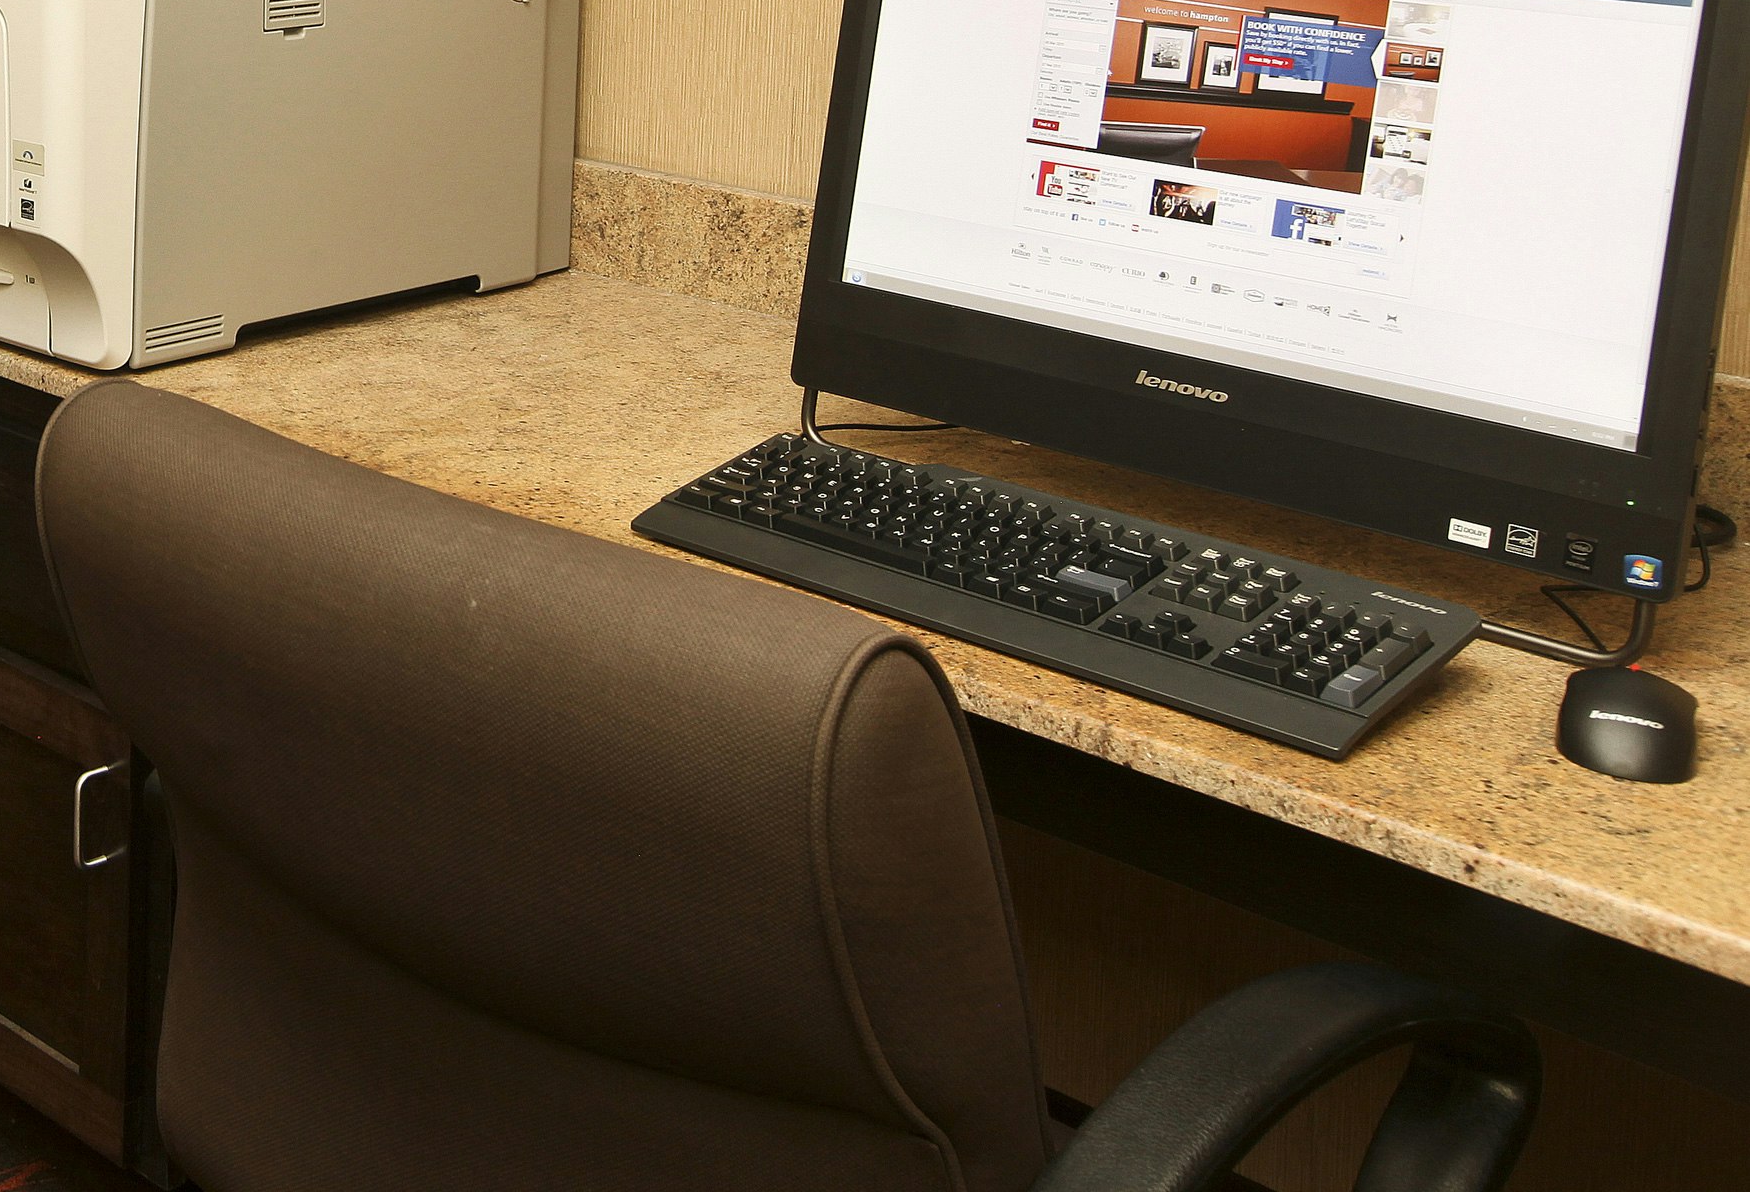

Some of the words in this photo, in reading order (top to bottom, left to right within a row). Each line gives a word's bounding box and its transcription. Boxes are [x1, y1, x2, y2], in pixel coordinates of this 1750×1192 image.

[1144, 5, 1178, 18] welcome
[1180, 9, 1188, 18] to
[1190, 10, 1228, 24] hampton
[1247, 21, 1276, 32] BOOK
[1277, 24, 1302, 36] WITH
[1304, 27, 1366, 42] CONFIDENCE
[1051, 175, 1061, 185] You
[1135, 369, 1229, 404] lenovo
[1370, 591, 1448, 615] lenovo
[1589, 710, 1665, 729] lenovo
